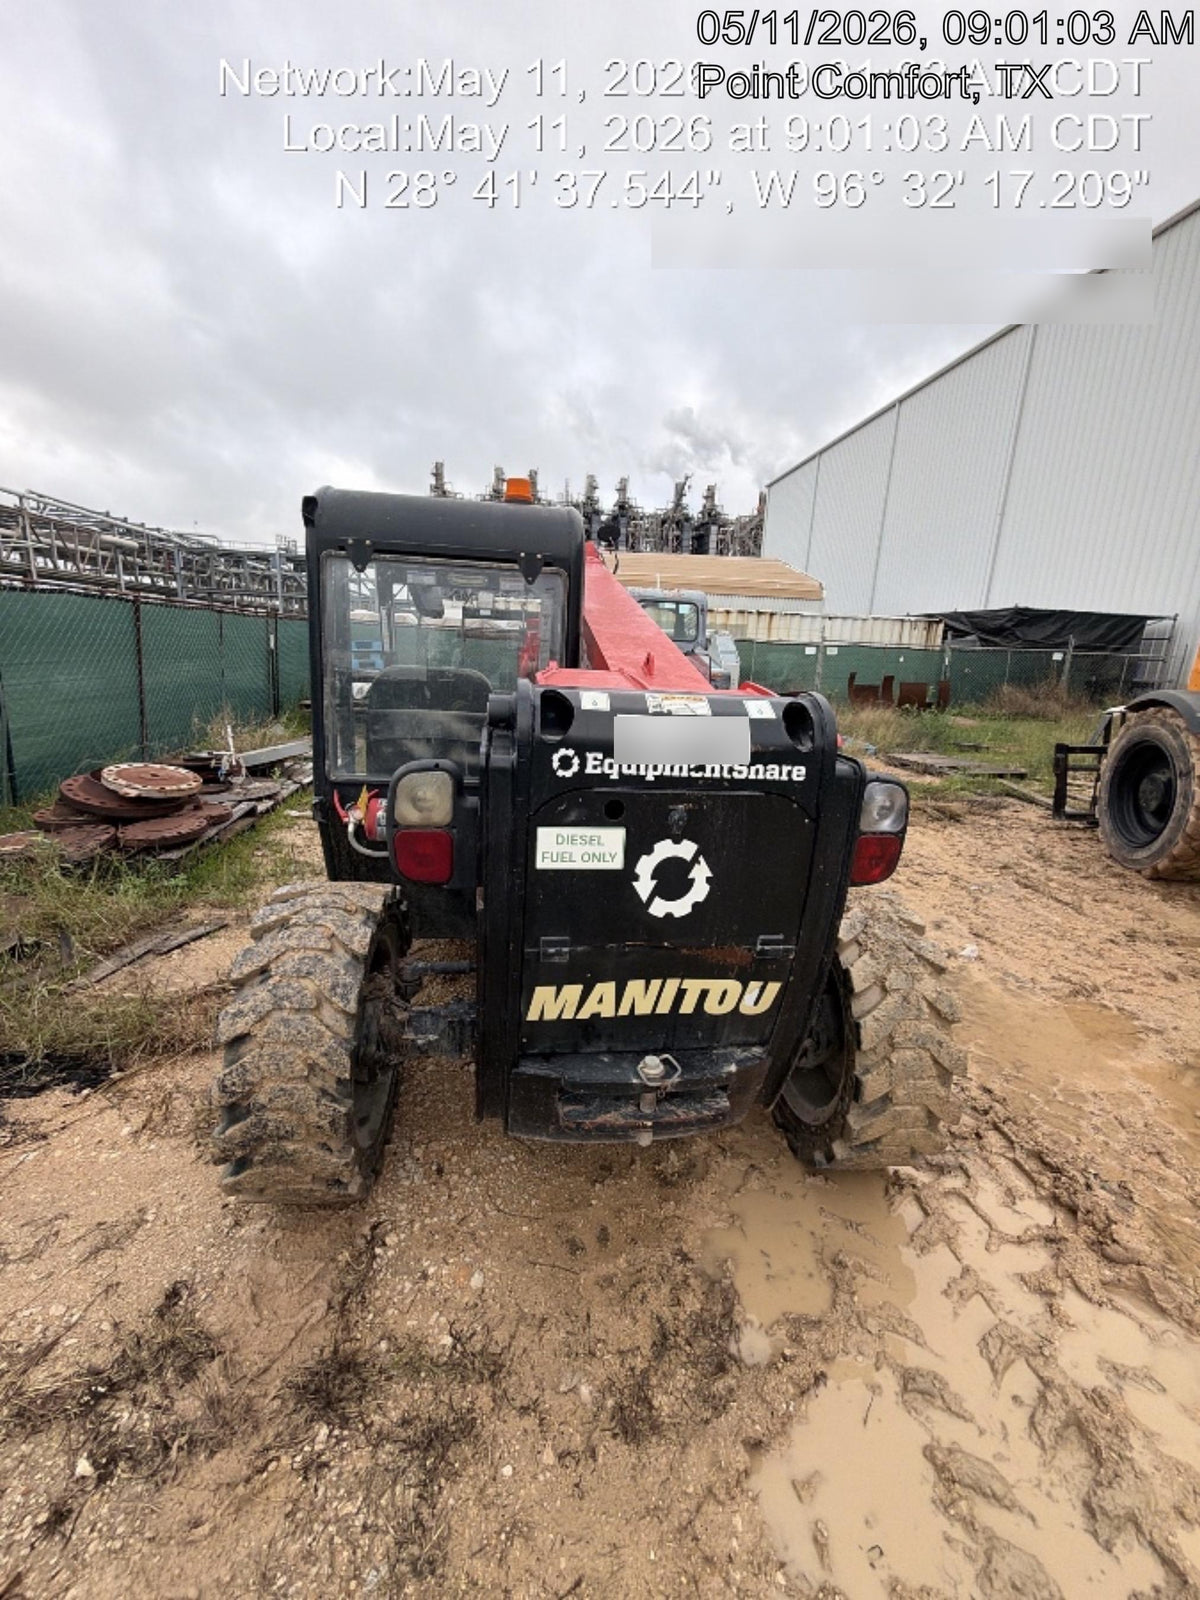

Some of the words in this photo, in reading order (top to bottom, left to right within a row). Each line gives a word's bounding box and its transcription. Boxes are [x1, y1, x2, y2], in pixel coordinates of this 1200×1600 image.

[555, 833, 605, 847] DIESEL
[541, 850, 577, 864] FUEL
[580, 851, 619, 864] ONLY
[525, 978, 783, 1022] MANITOU
